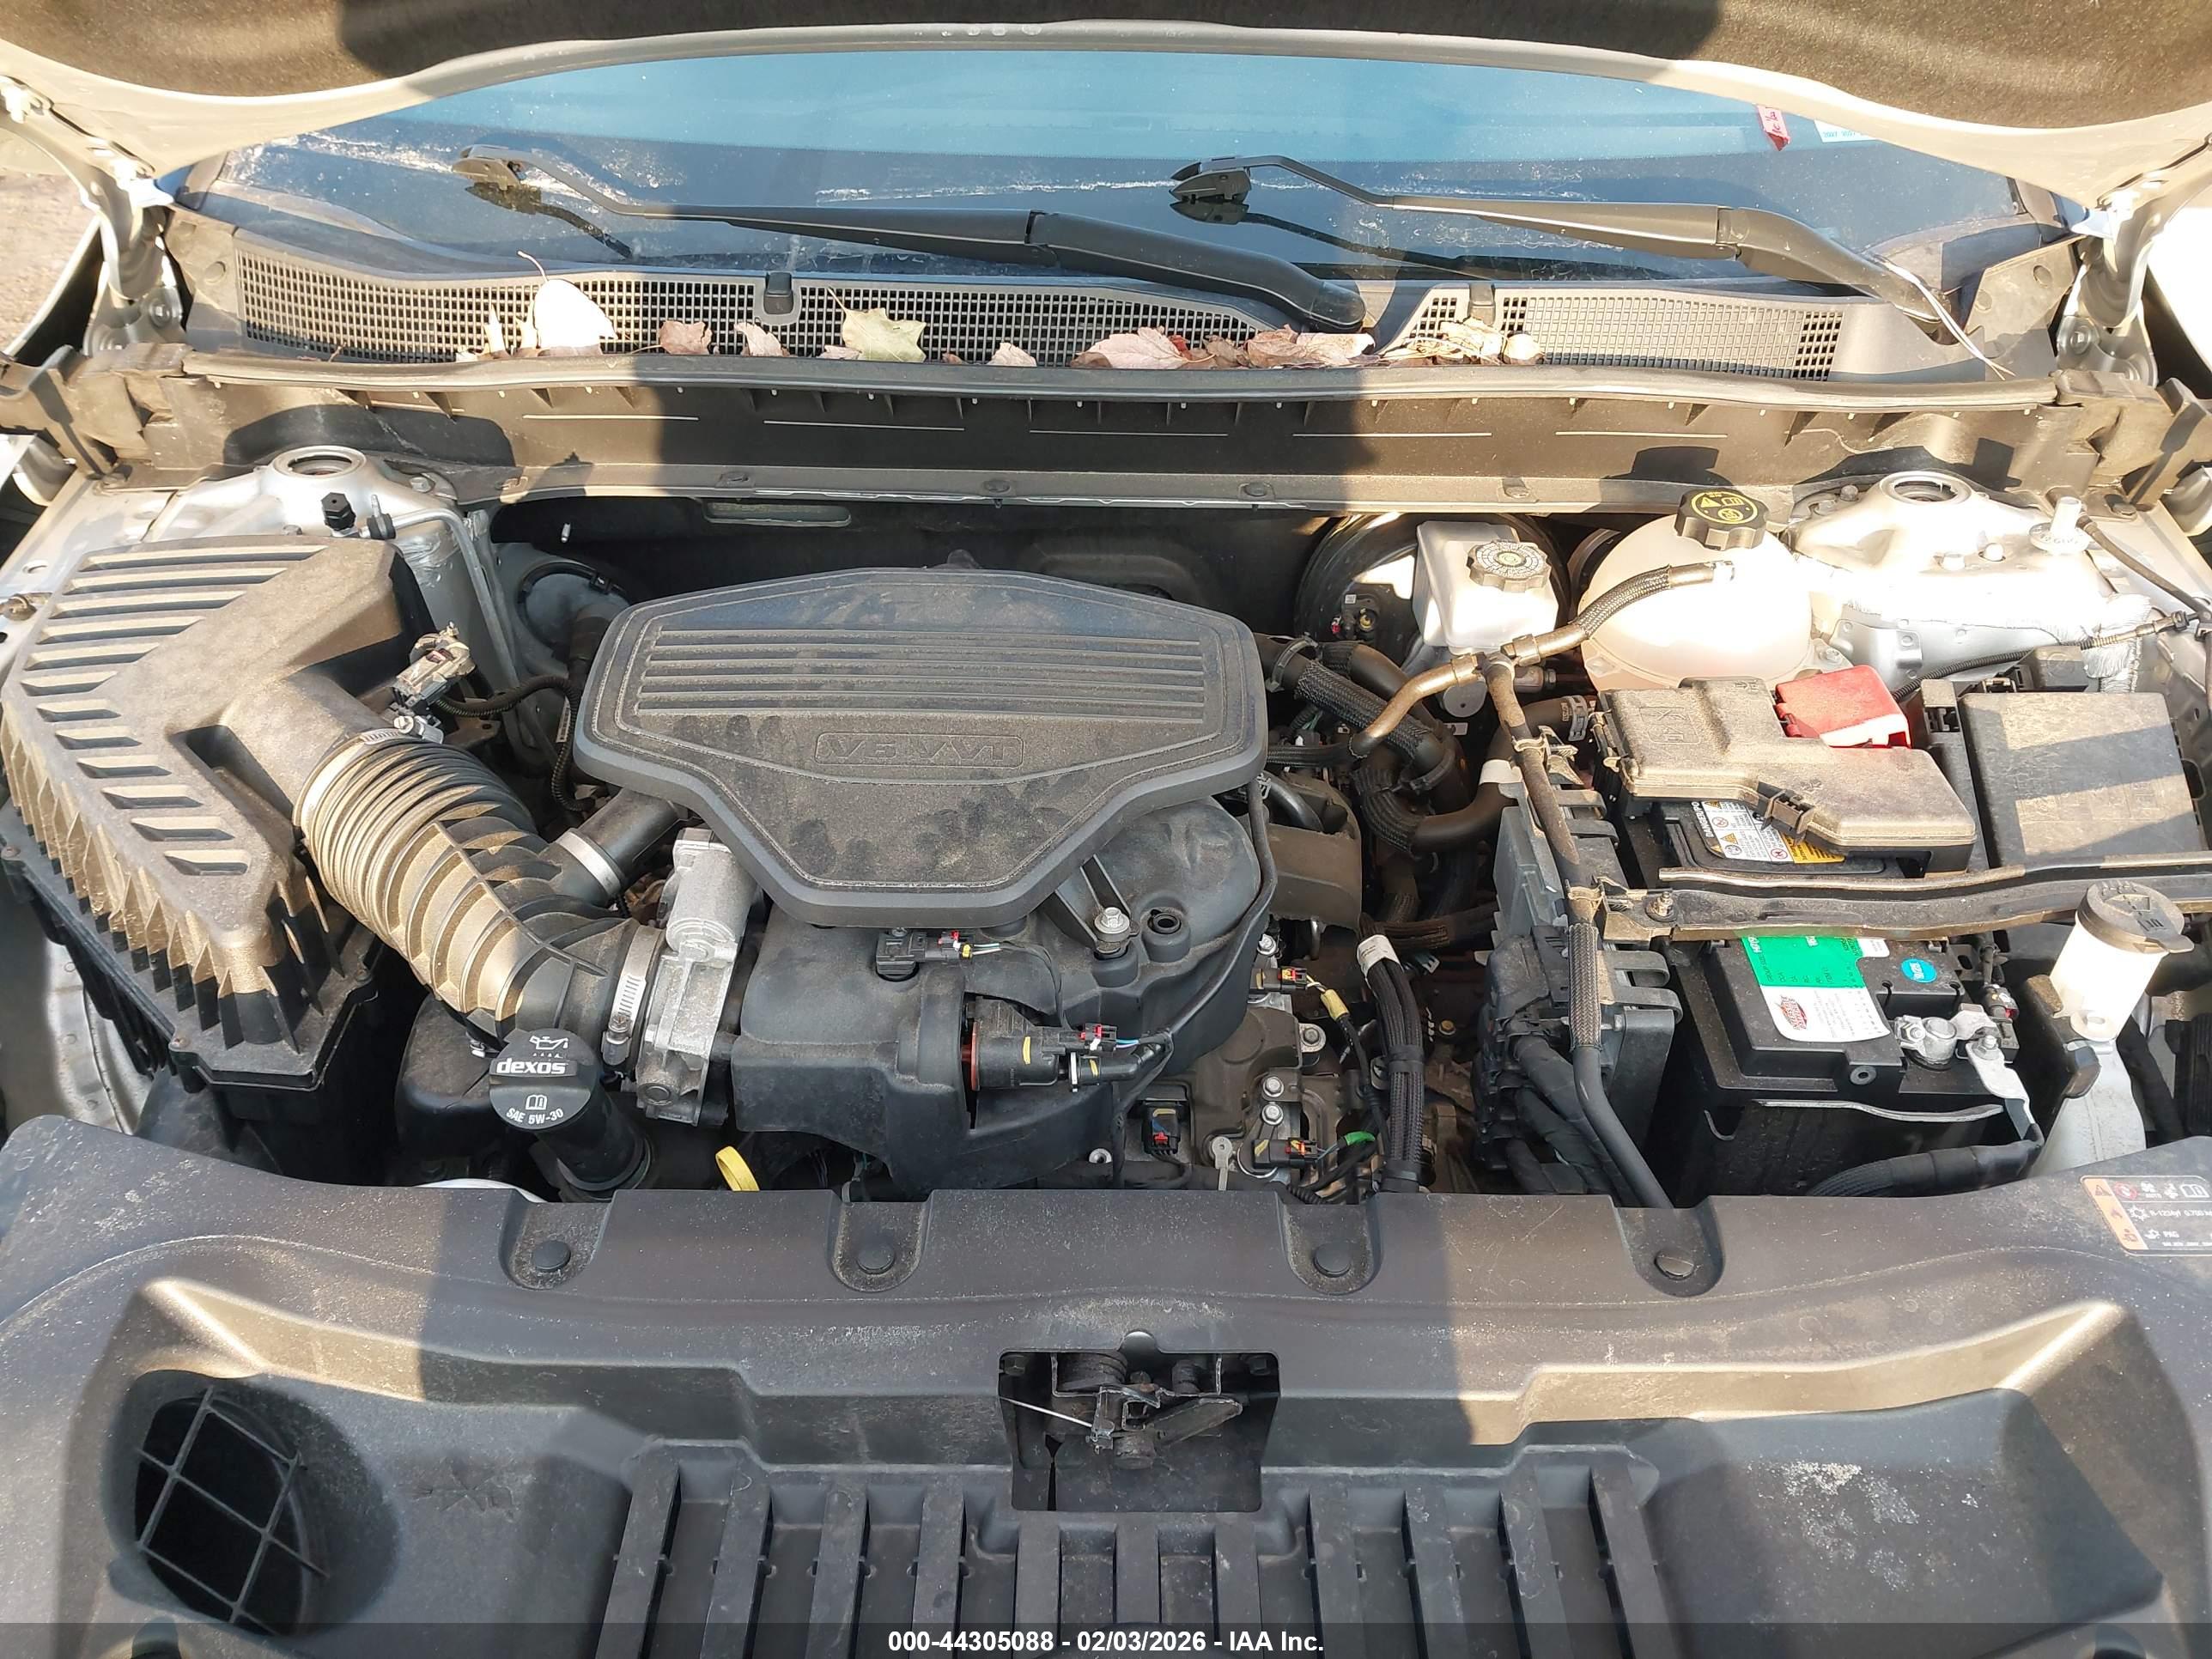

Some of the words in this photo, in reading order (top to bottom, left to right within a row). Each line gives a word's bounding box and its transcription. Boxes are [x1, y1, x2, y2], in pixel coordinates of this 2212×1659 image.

[496, 1058, 566, 1074] dexos
[506, 1108, 526, 1123] SAE
[528, 1109, 564, 1125] 5W-30
